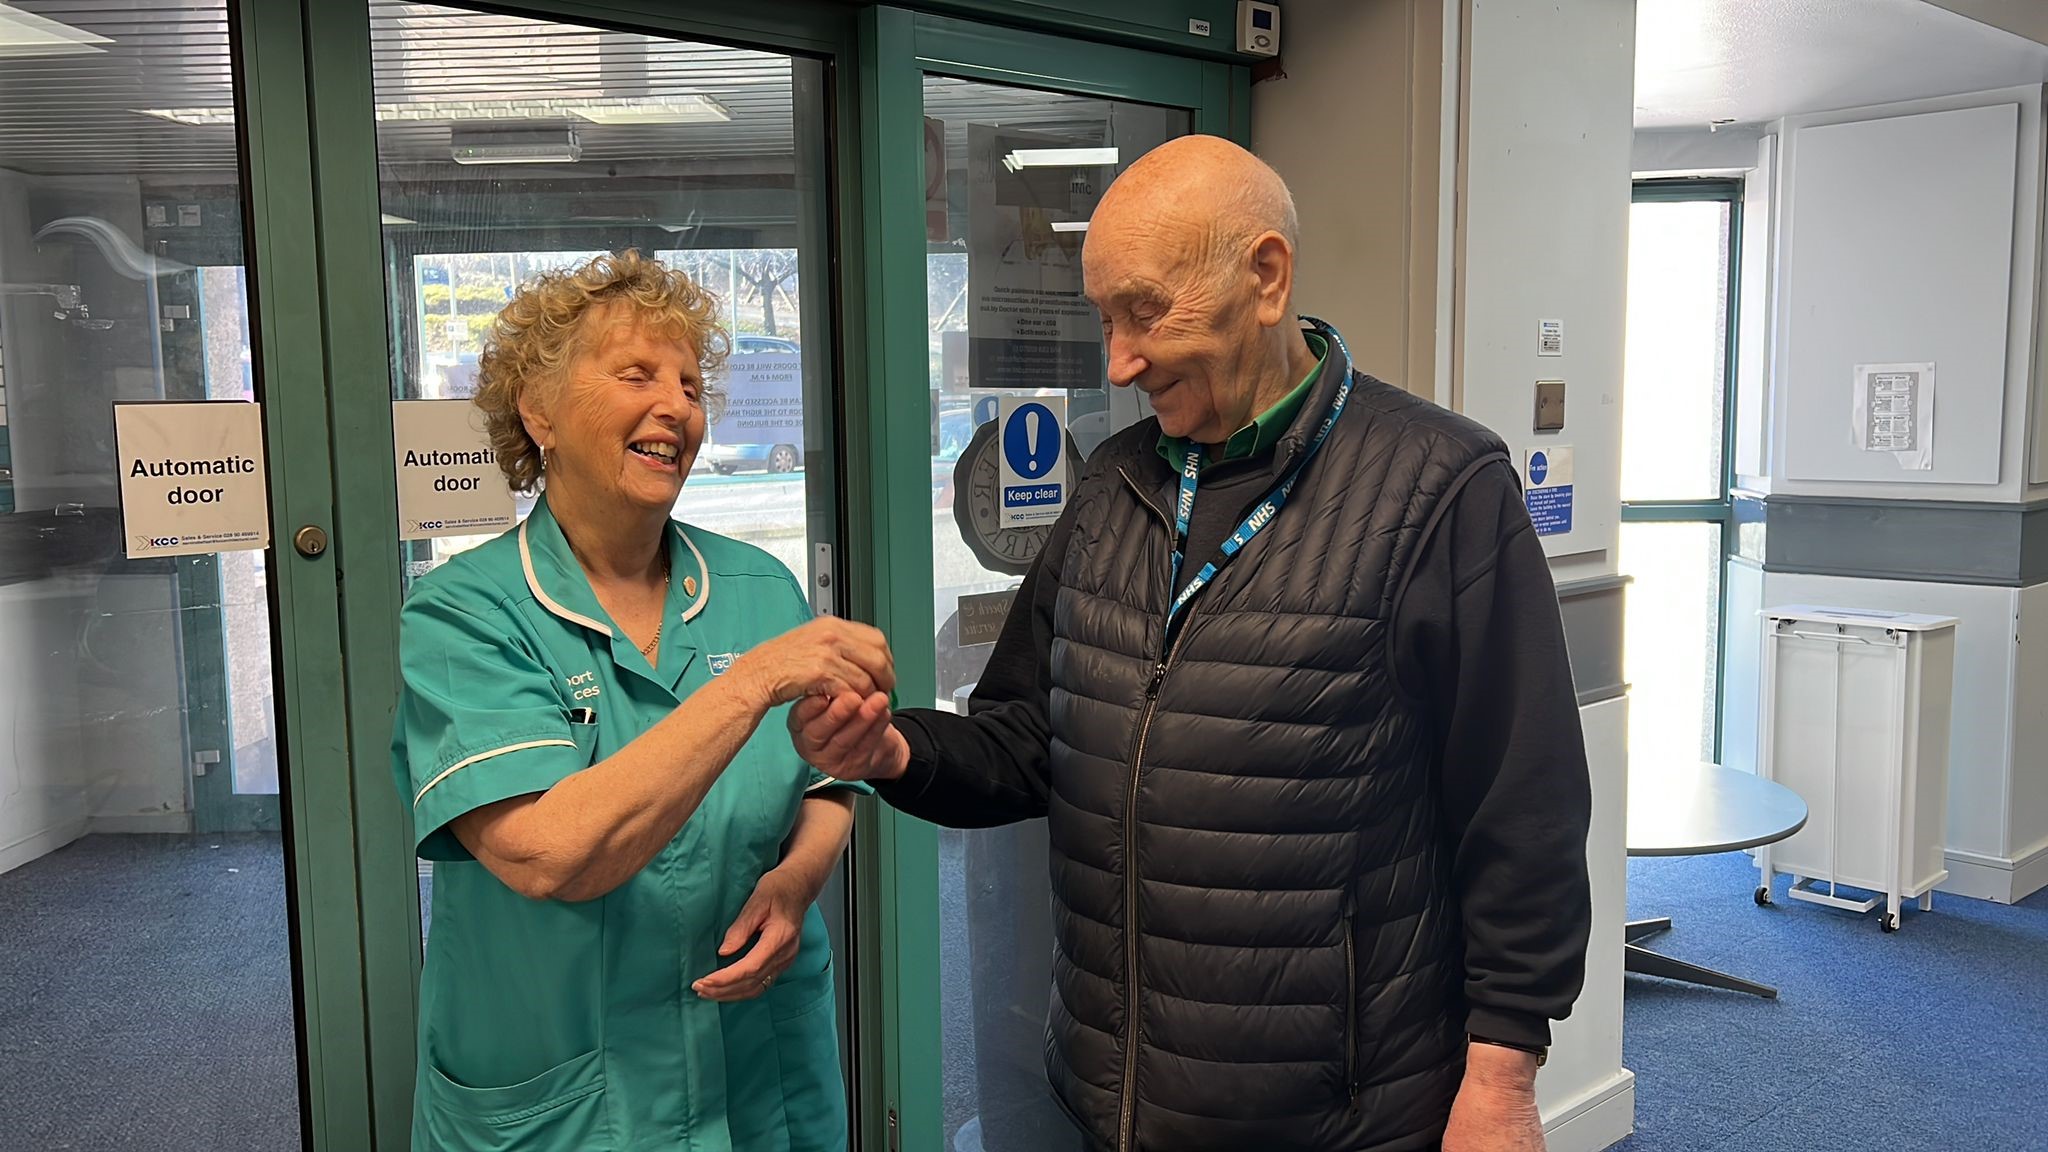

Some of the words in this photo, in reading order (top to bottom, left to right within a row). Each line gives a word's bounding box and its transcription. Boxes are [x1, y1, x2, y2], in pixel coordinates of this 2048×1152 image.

[1333, 382, 1349, 410] NHS
[130, 455, 255, 478] Automatic
[404, 448, 495, 467] Automati
[1184, 452, 1200, 480] NHS
[433, 475, 481, 492] door
[167, 486, 224, 505] door
[1008, 490, 1033, 503] Keep
[1034, 489, 1058, 499] clear
[1179, 488, 1194, 520] NHS
[419, 520, 443, 530] KCC
[1247, 500, 1276, 532] NHS
[150, 536, 179, 547] KCC
[1233, 533, 1245, 546] S
[1176, 576, 1203, 605] NHS
